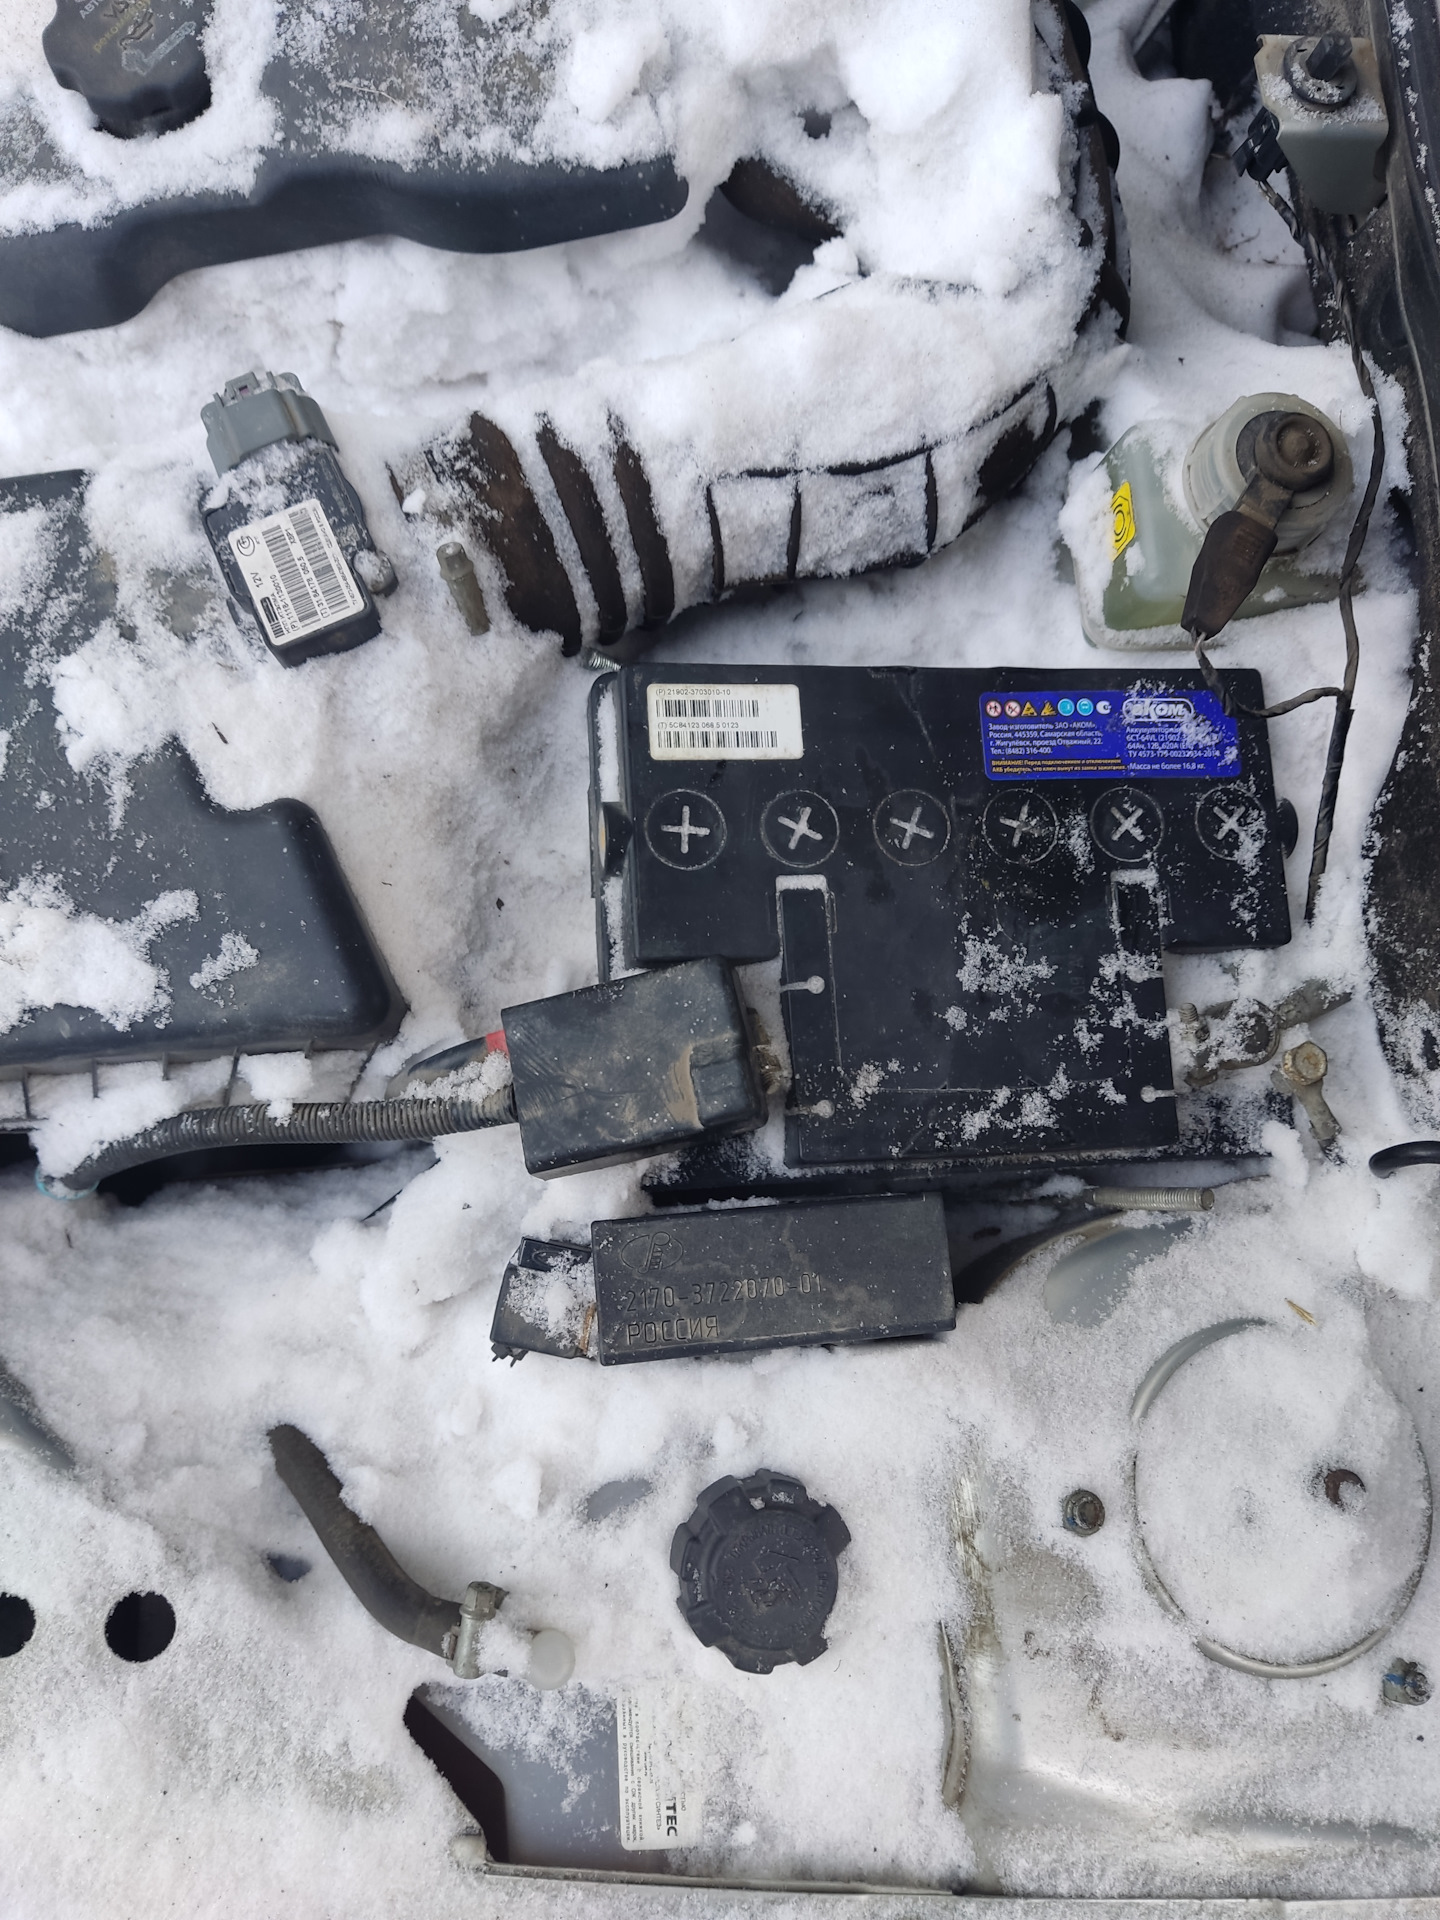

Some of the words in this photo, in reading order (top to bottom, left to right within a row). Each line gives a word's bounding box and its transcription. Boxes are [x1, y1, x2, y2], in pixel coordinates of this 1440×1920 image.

[250, 570, 263, 588] 12V
[655, 688, 666, 696] (P)
[667, 688, 731, 696] 21902-3703010-10
[657, 722, 668, 730] (T)
[626, 1273, 823, 1312] 2170-3722070-01
[626, 1315, 720, 1346] РОССИЯ
